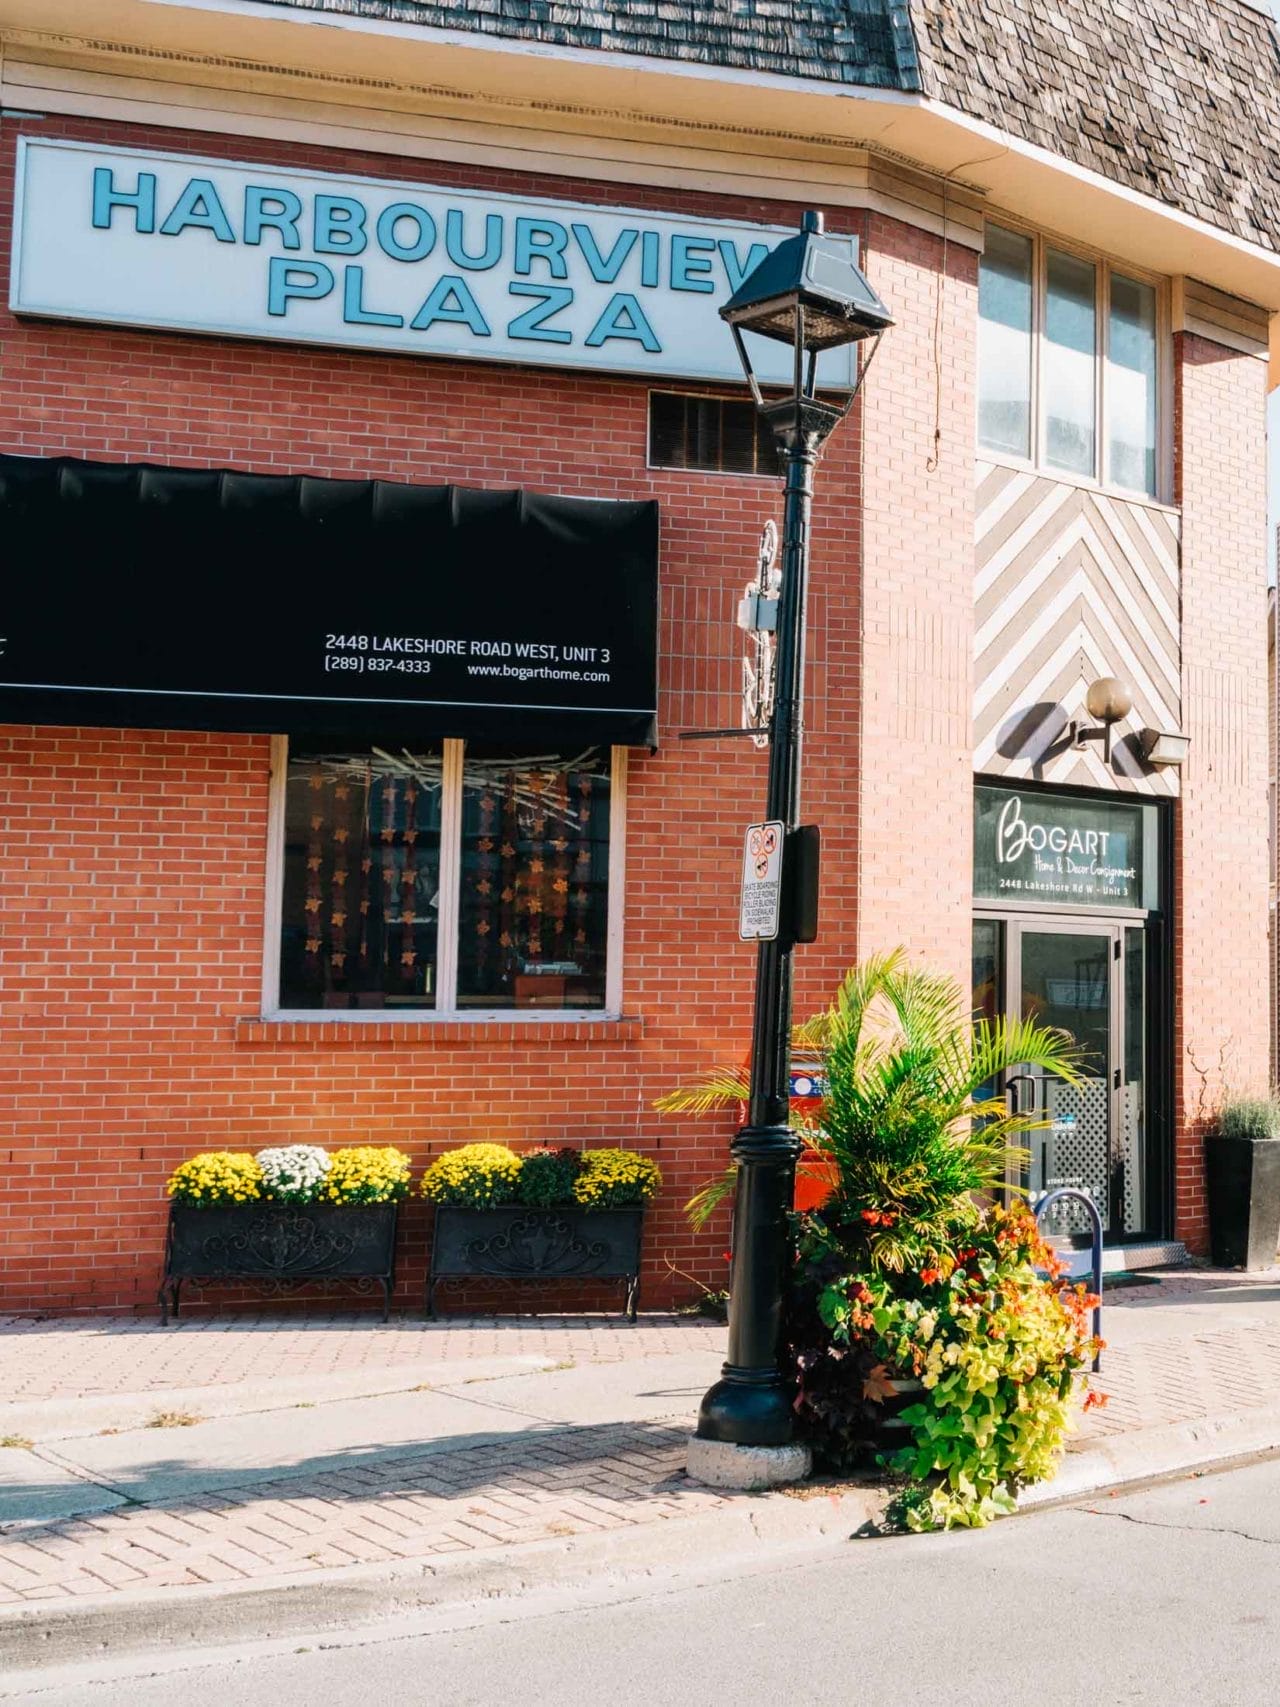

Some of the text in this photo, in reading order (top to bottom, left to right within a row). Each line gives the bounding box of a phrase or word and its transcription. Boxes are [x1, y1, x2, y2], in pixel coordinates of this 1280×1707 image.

[268, 256, 662, 353] PLAZA
[325, 634, 611, 663] 2448 LAKESHORE ROAD WEST, UNIT 3
[324, 655, 431, 673] (289) 837-4333
[467, 664, 611, 682] www.bogarthome.com
[997, 796, 1109, 863] BOGART
[1034, 853, 1136, 884] Home & Decor Consignment
[1000, 879, 1022, 889] 2448
[1025, 880, 1069, 892] Lakeshore
[1072, 883, 1083, 893] Rd
[1086, 884, 1093, 894] W
[1103, 886, 1120, 896] Unit
